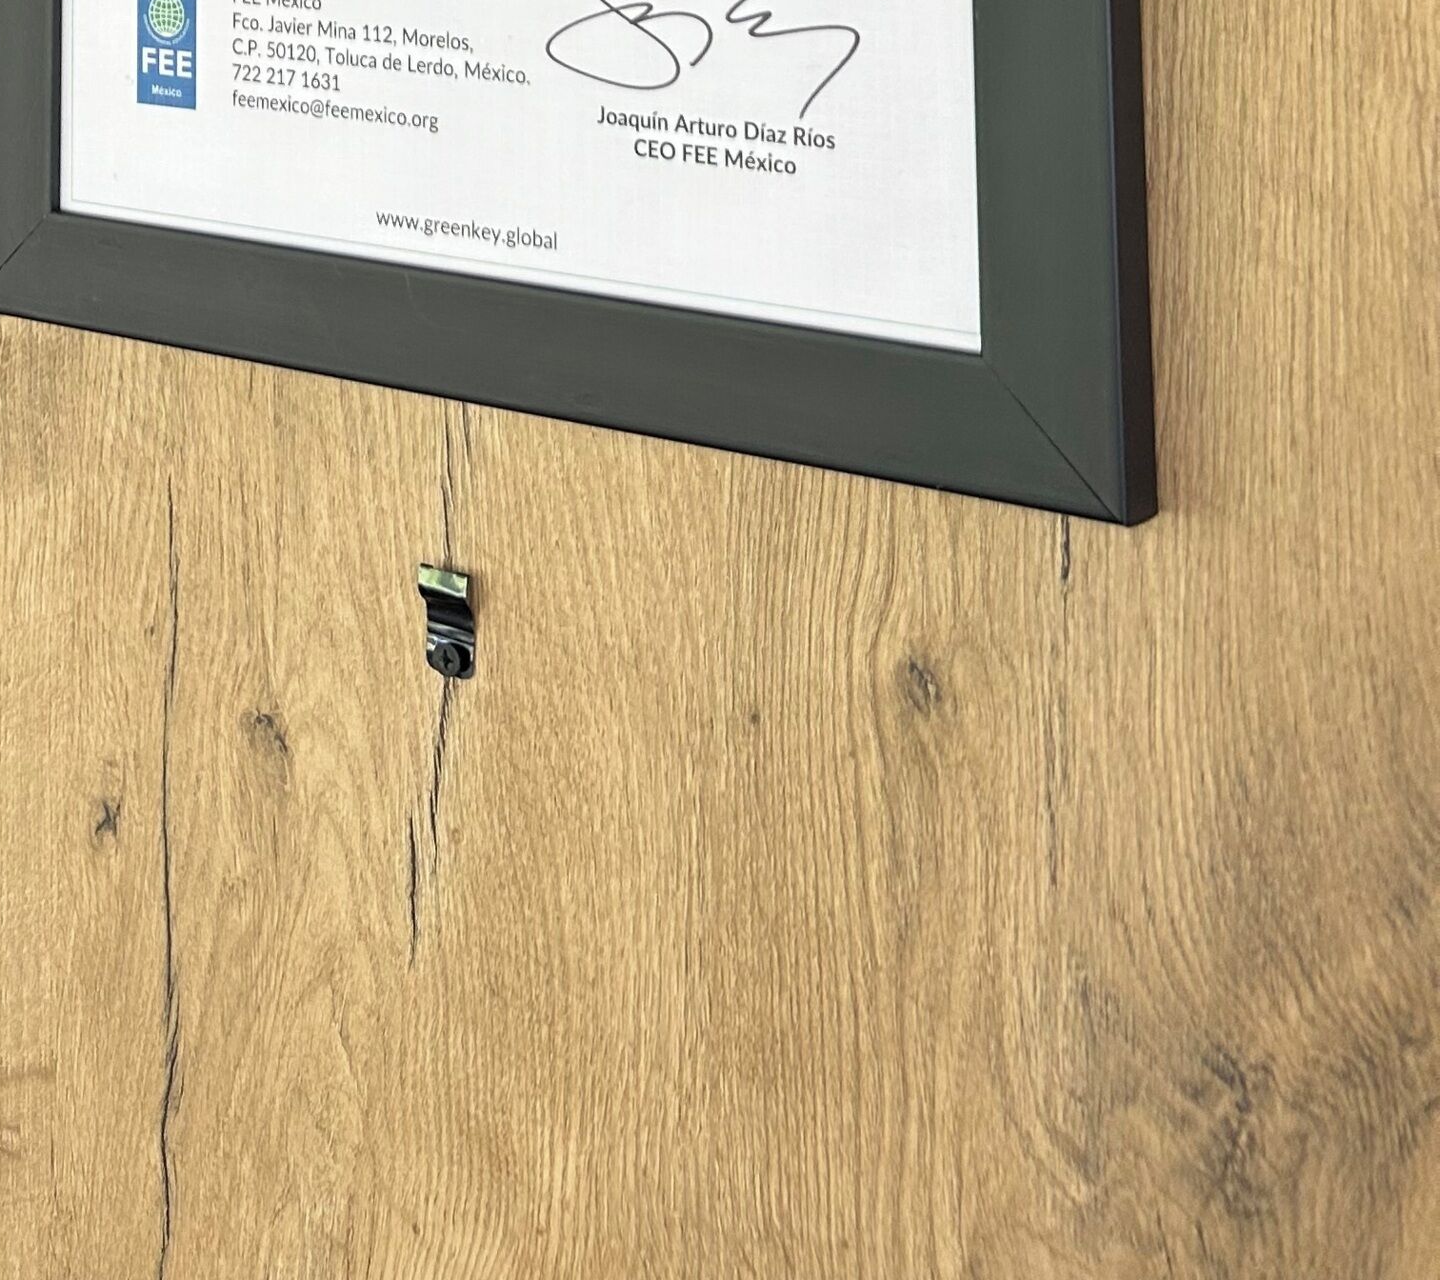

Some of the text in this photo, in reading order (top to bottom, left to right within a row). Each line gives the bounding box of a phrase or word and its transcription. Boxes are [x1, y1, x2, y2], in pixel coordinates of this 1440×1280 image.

[232, 11, 474, 55] Fco. Javier Mina 112, Morelos,
[142, 46, 193, 79] FEE
[231, 37, 531, 86] C.P. 50120, Toluca de Lerdo, México.
[231, 62, 341, 93] 722 217 1631
[232, 88, 439, 134] feemexico@feemexico.org
[596, 104, 836, 151] Joaquín Arturo Díaz Ríos
[633, 137, 797, 176] CEO FEE México
[375, 211, 558, 251] www.greenkey.global
